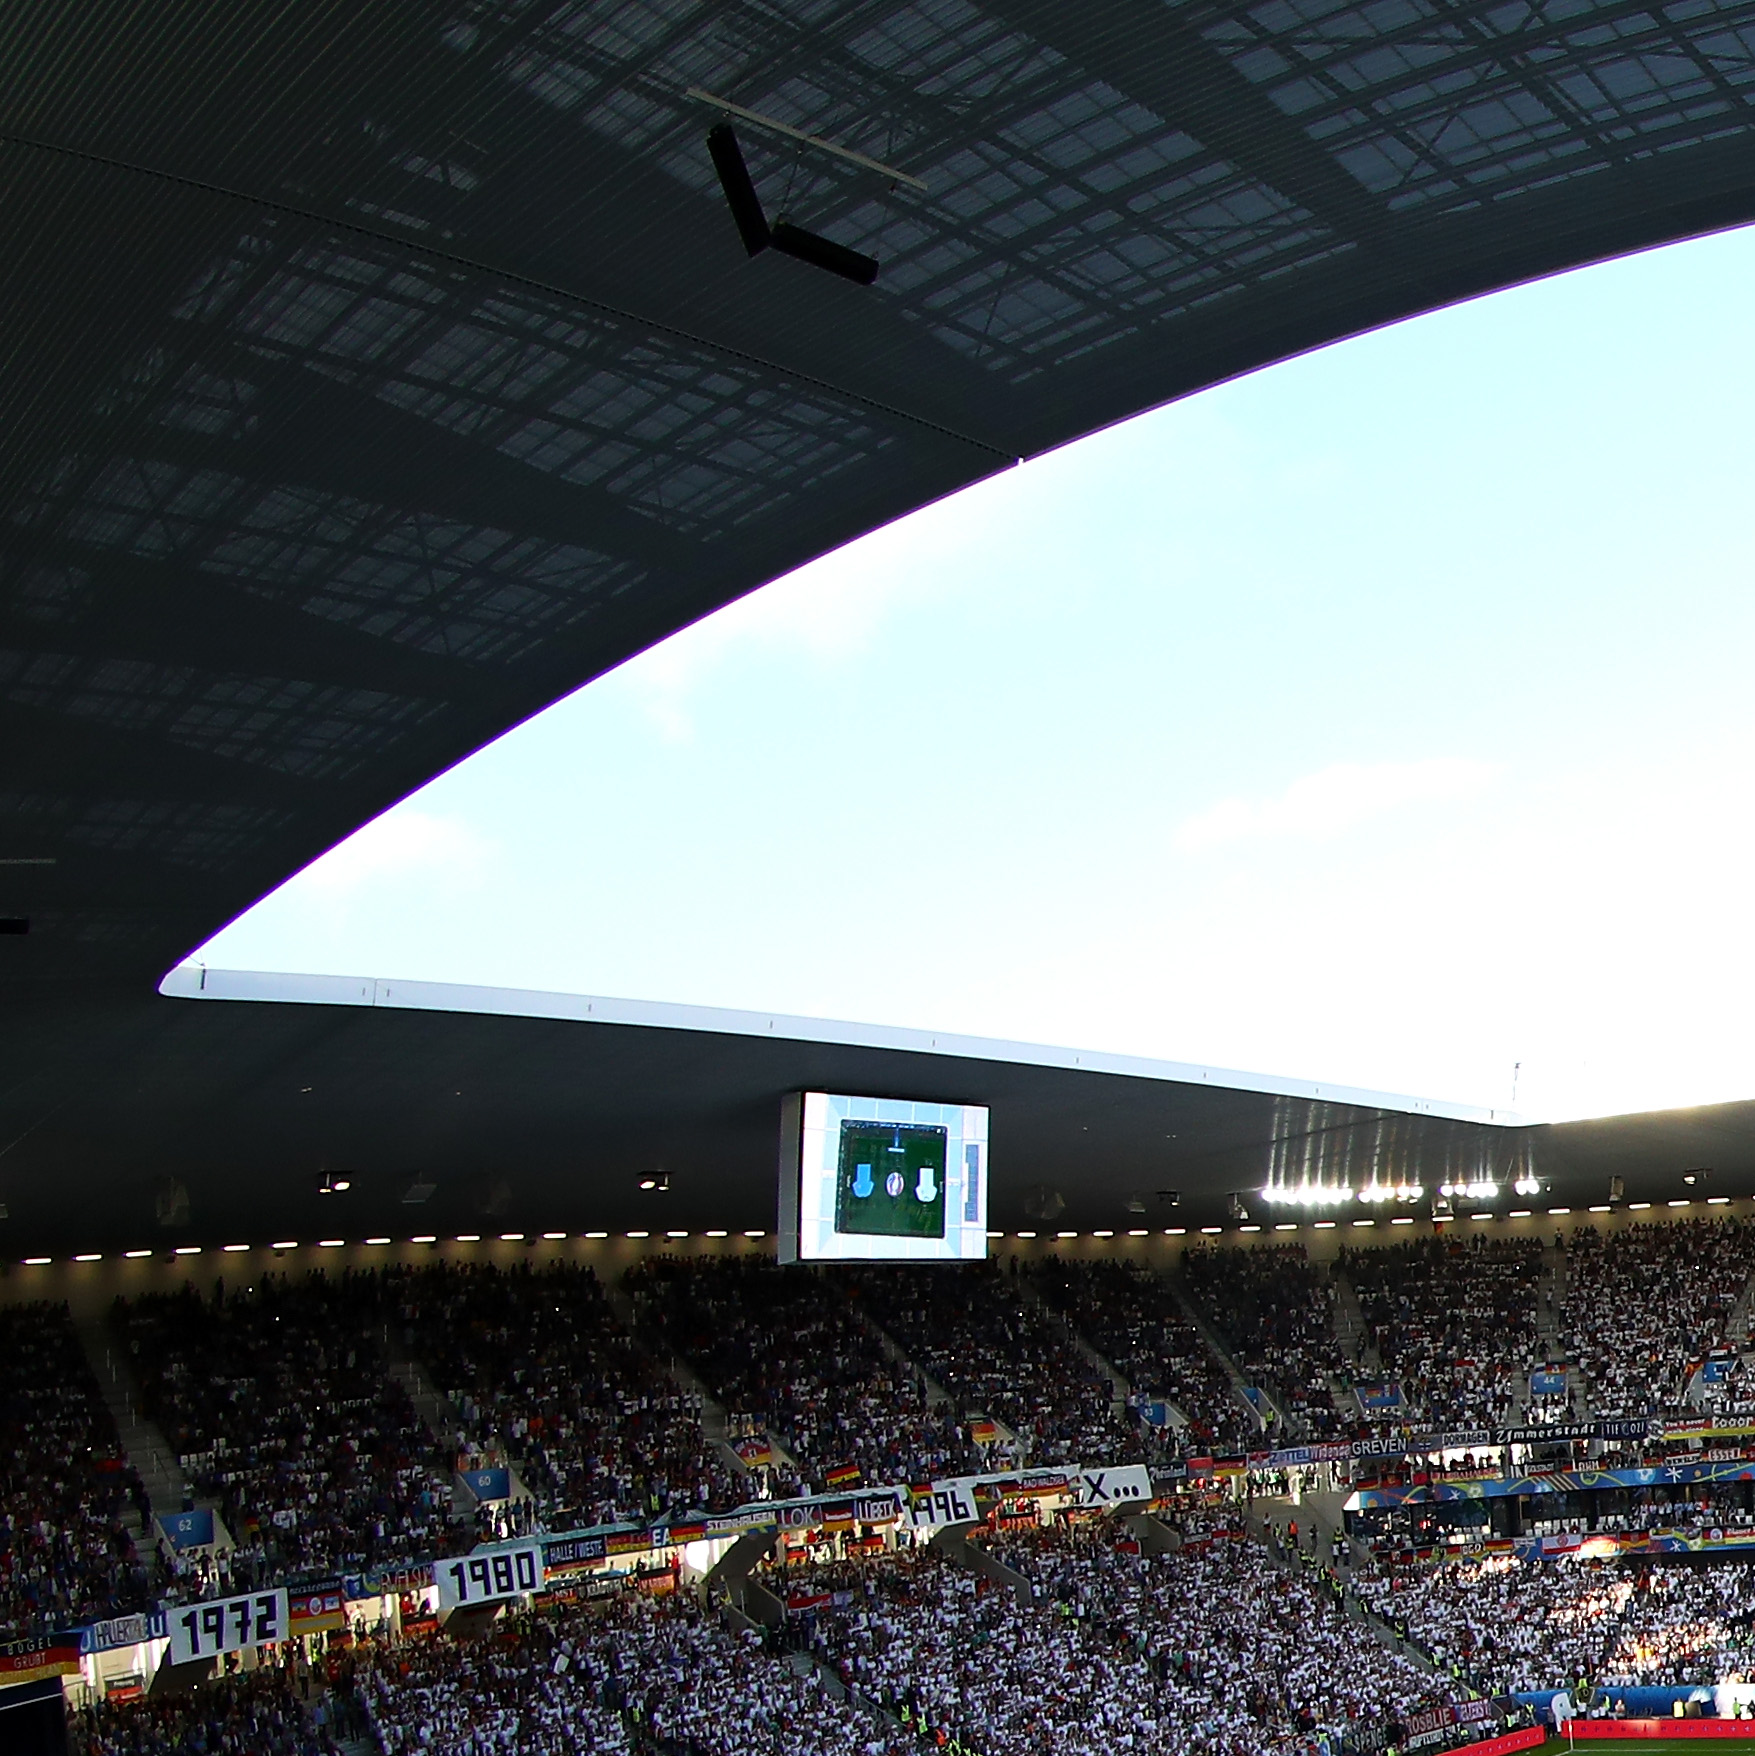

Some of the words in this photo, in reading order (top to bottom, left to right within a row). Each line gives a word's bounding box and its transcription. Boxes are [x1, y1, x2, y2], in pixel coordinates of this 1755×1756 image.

[1351, 1438, 1408, 1457] GREVEN
[780, 1505, 815, 1529] LOK
[449, 1551, 538, 1601] 1980
[181, 1594, 278, 1656] 1972
